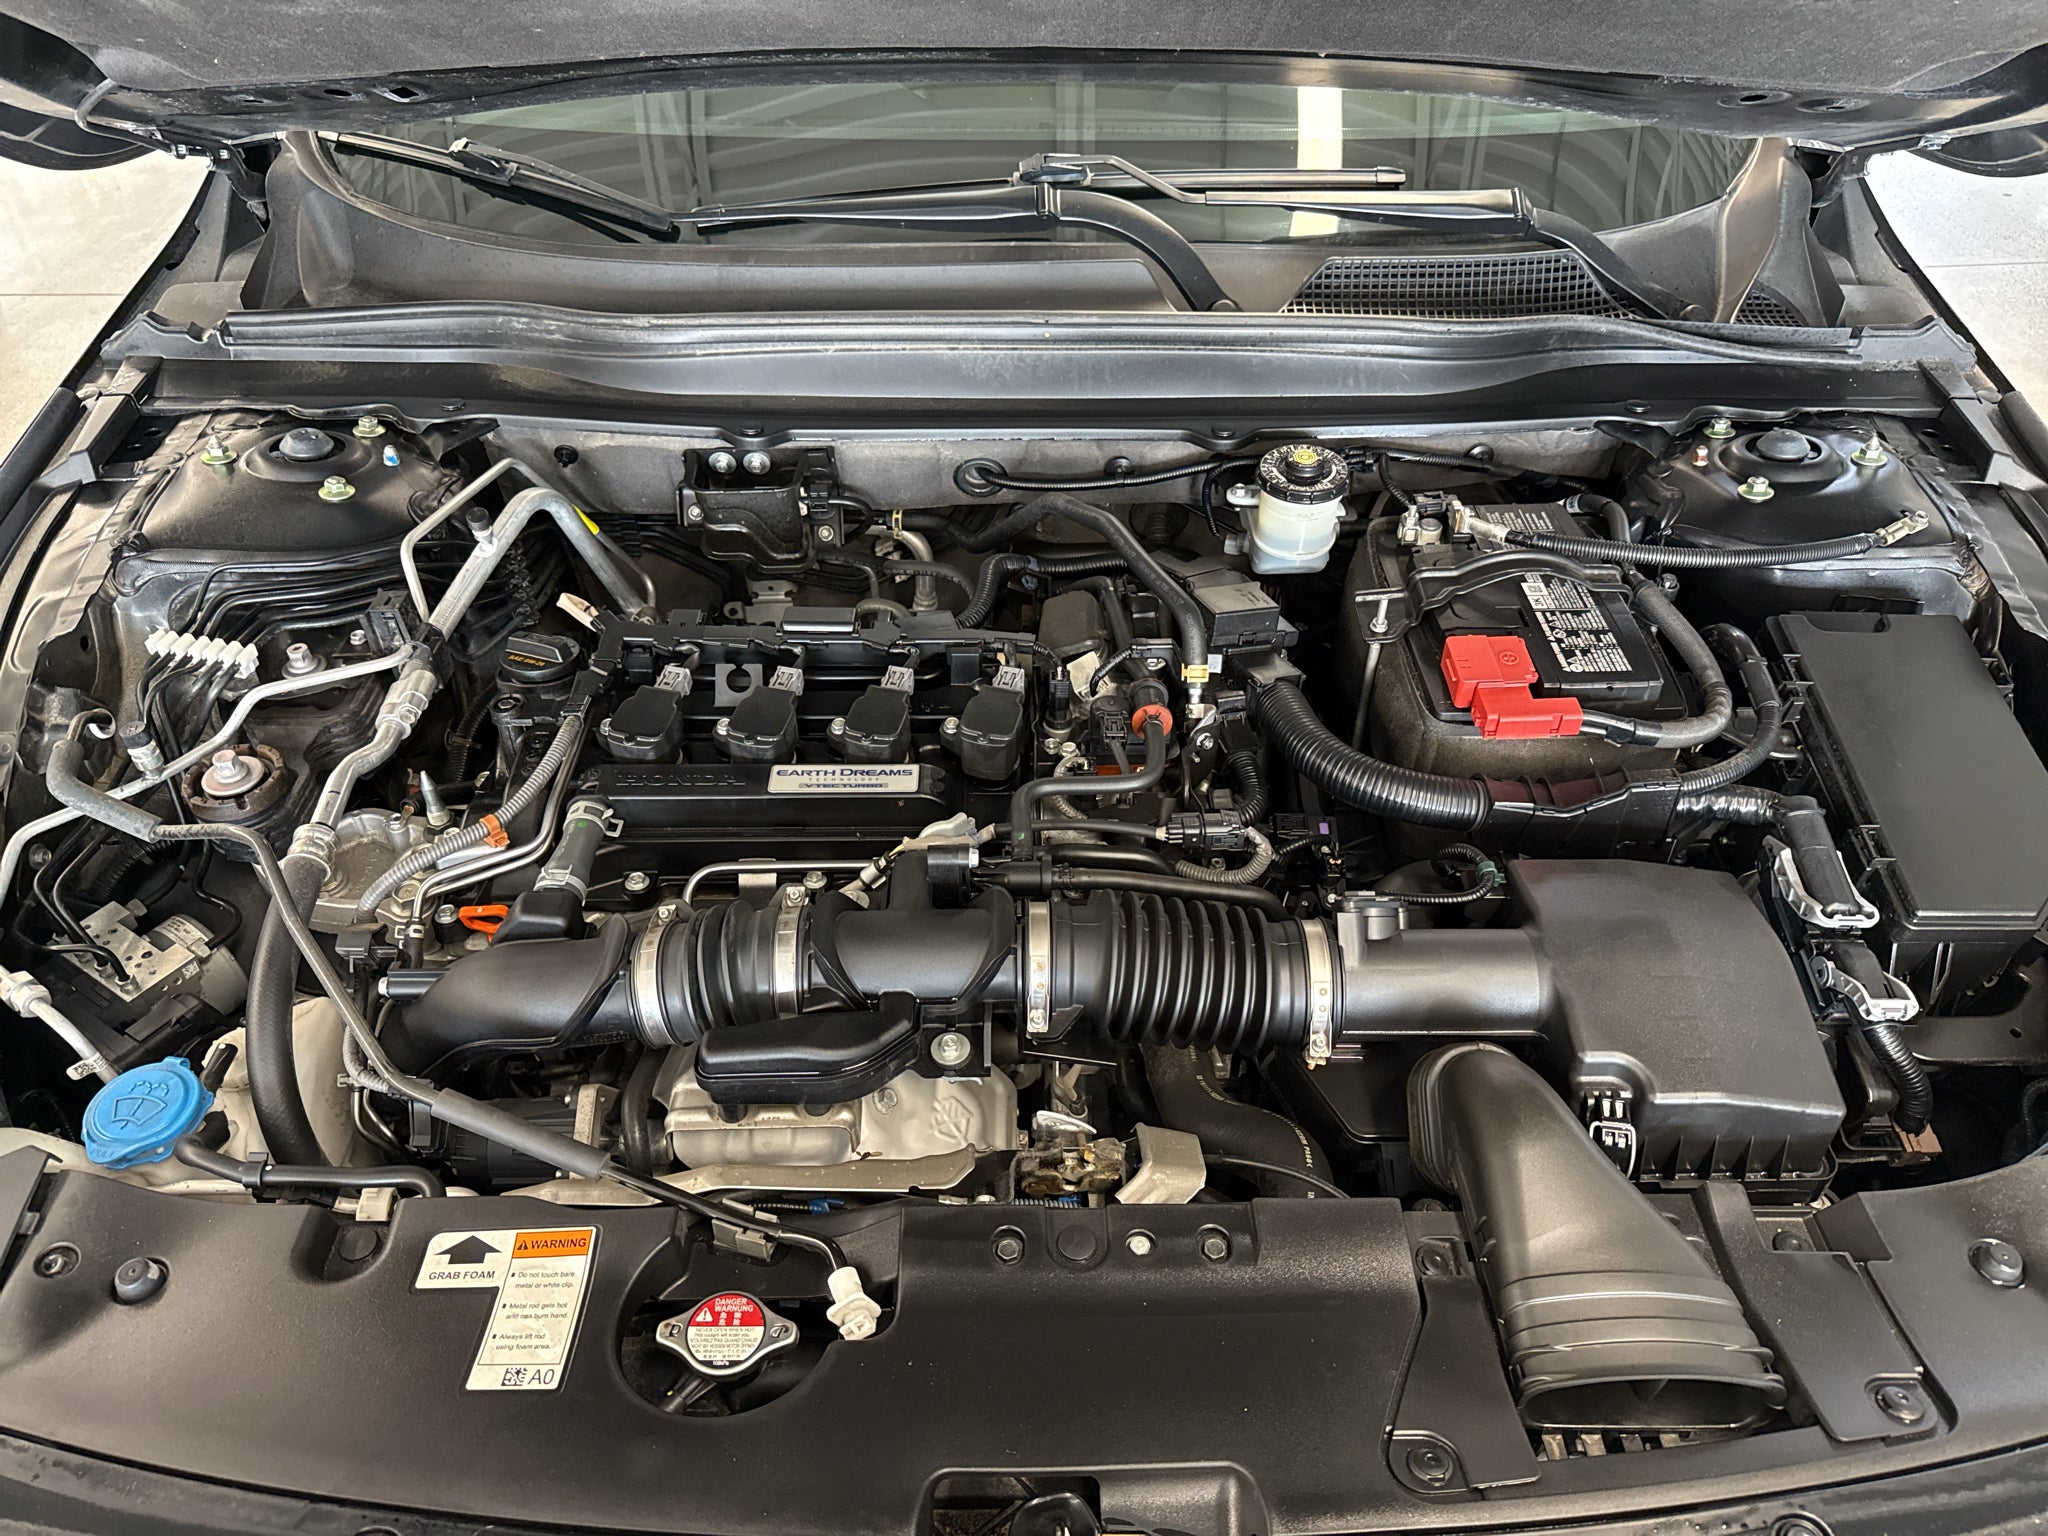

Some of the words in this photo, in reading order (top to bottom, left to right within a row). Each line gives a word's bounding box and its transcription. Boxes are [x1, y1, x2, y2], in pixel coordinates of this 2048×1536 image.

[776, 769, 836, 777] EARTH
[839, 768, 913, 777] DREAMS
[615, 774, 747, 786] HONDA
[531, 1237, 588, 1250] WARNING
[428, 1271, 460, 1280] GRAB
[463, 1270, 496, 1280] FOAM
[561, 1281, 574, 1290] clip.
[715, 1298, 748, 1306] DANGER
[541, 1303, 556, 1311] gets
[499, 1333, 523, 1341] Always
